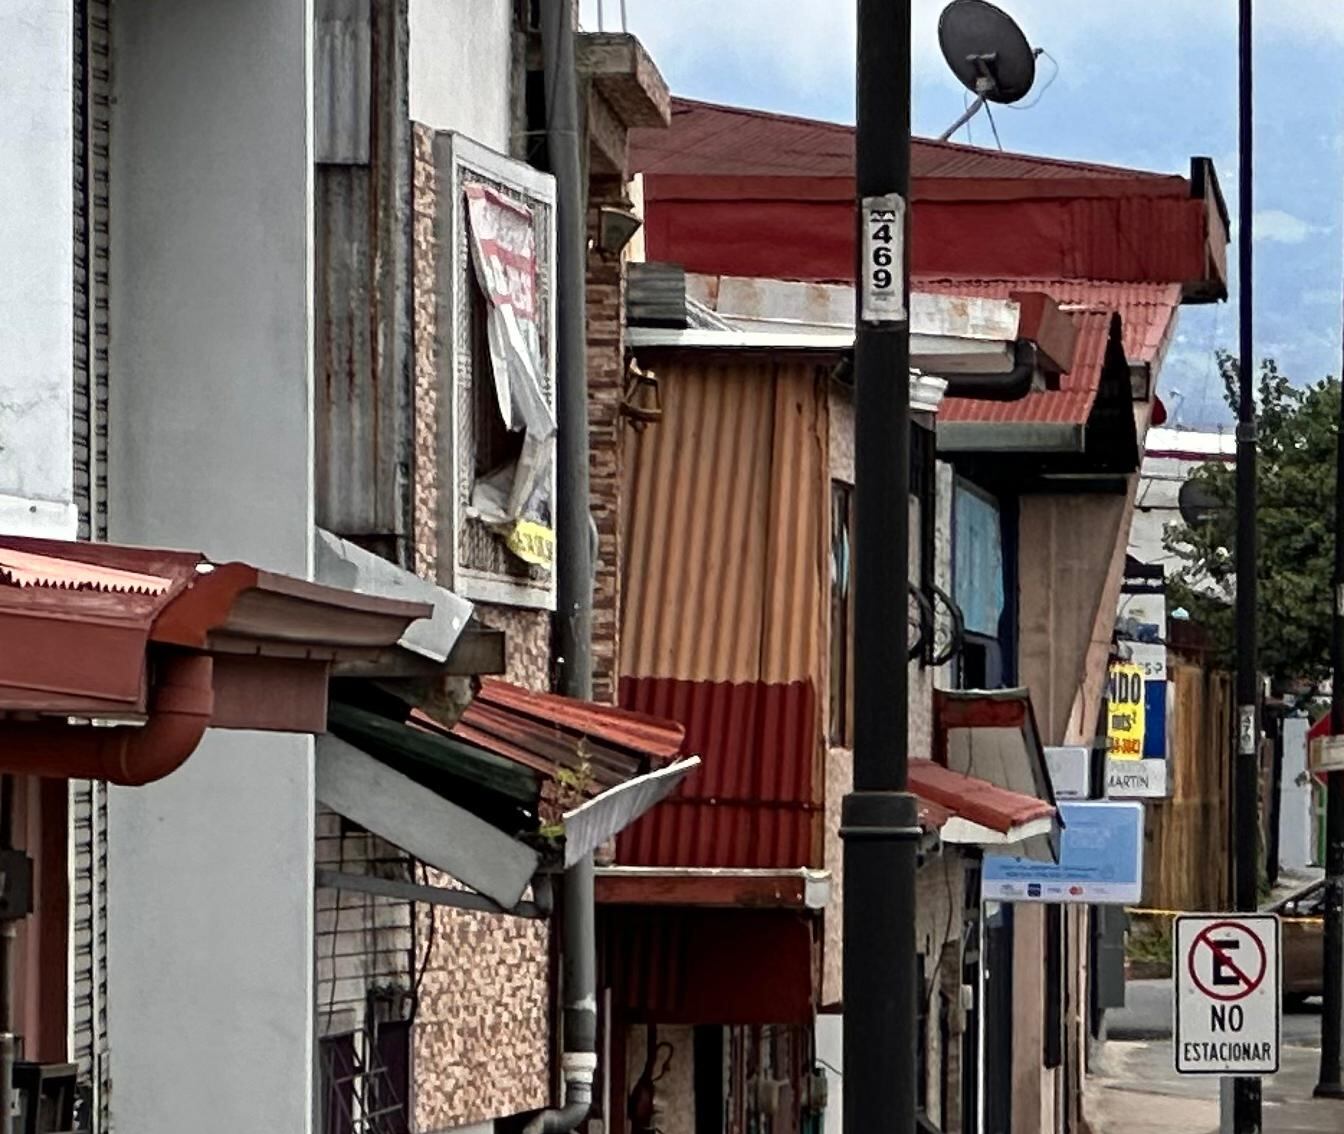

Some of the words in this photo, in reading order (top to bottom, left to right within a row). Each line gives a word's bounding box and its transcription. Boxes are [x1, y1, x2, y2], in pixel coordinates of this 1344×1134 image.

[872, 224, 893, 288] 469
[1211, 1004, 1243, 1032] NO
[1183, 1042, 1272, 1062] ESTACIONAR
